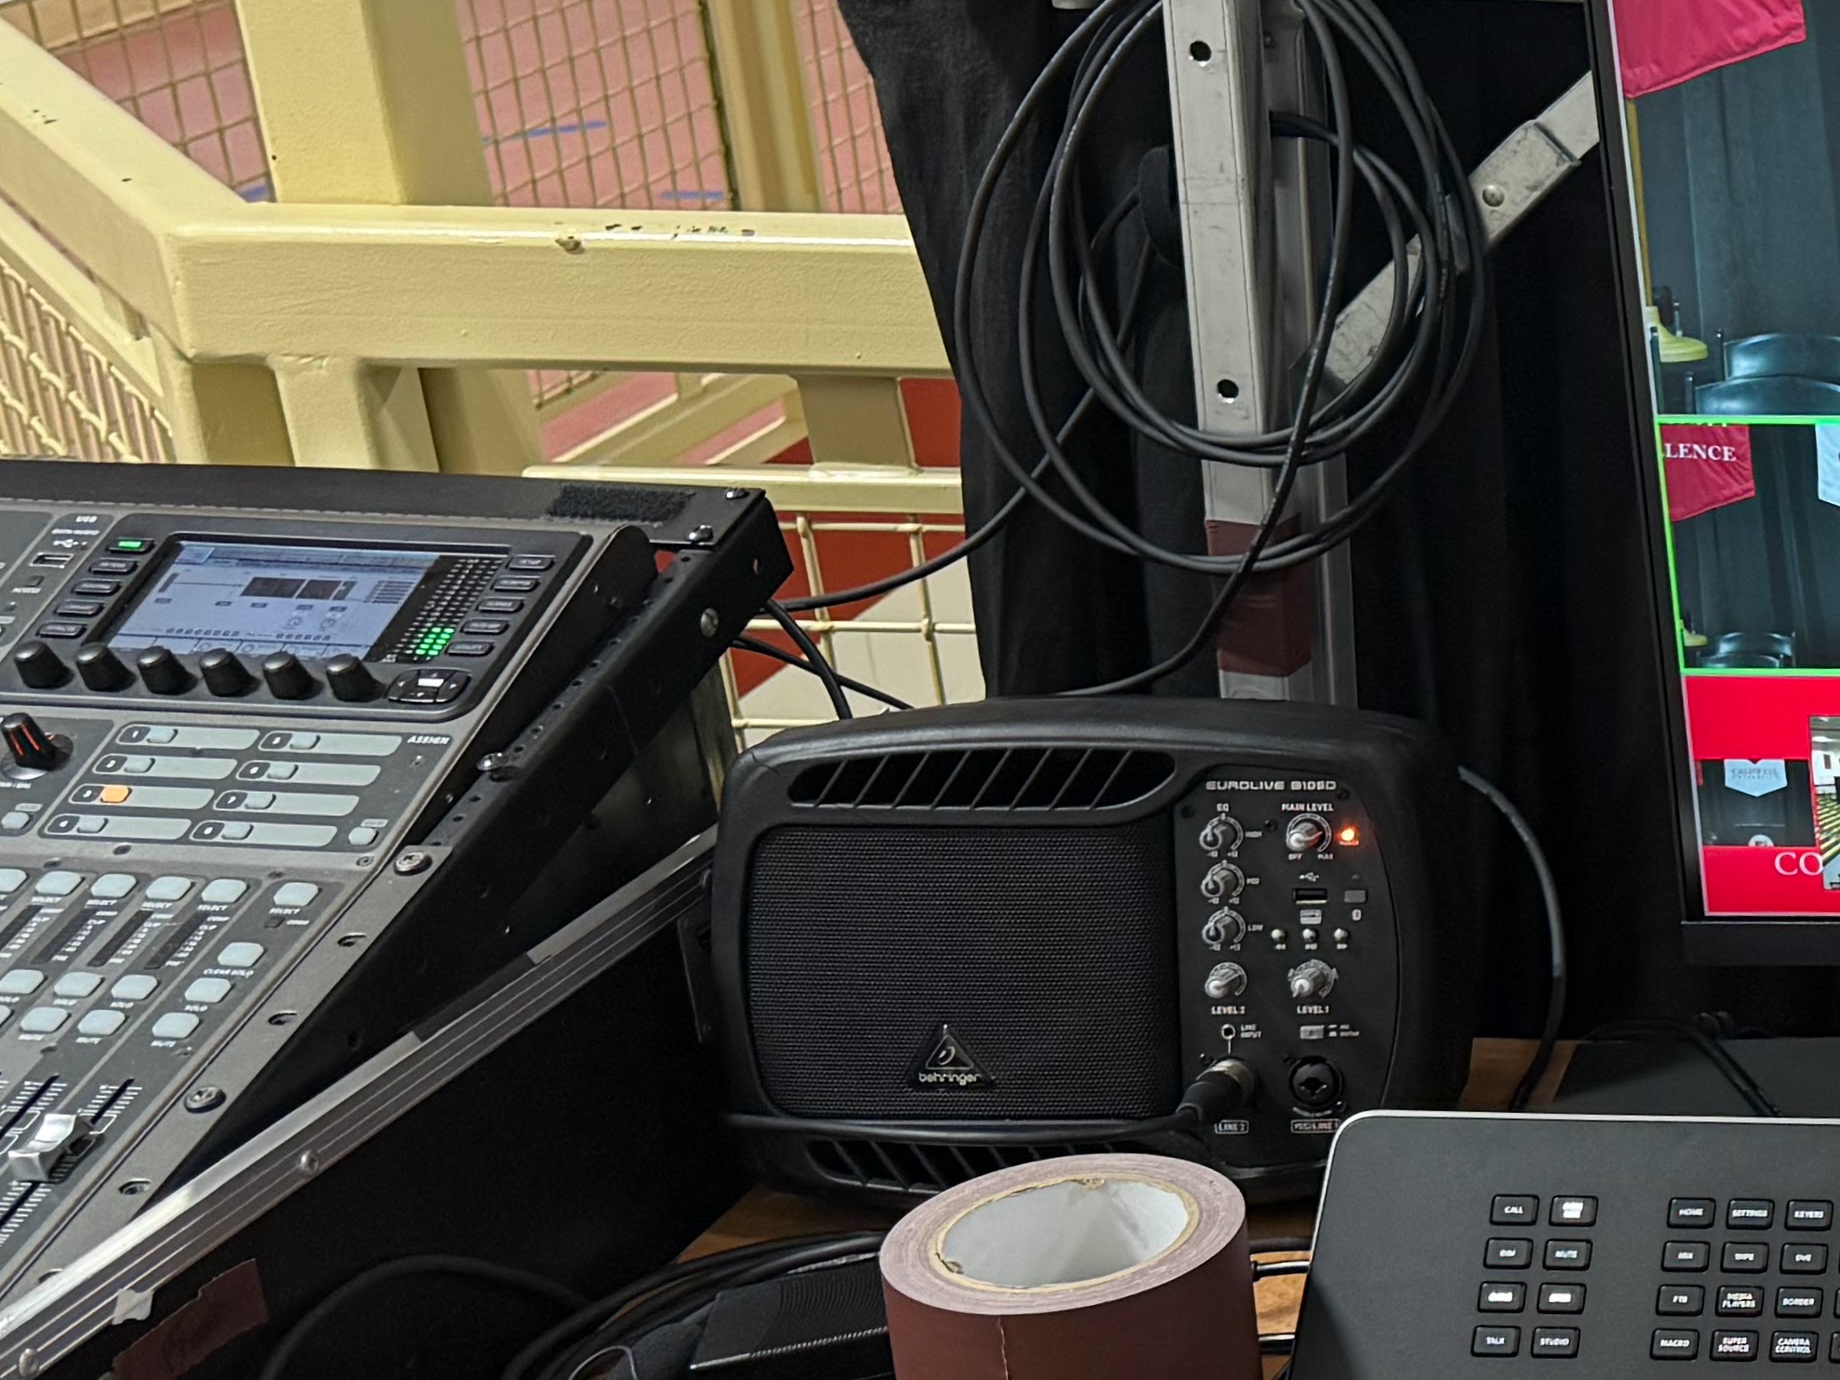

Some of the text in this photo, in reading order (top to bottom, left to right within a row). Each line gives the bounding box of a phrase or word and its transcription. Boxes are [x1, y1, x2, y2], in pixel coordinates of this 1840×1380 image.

[407, 734, 451, 746] ASSIGN
[1206, 780, 1285, 790] EUROLIVE
[1281, 803, 1334, 812] MAIN LEVEL
[1211, 1005, 1237, 1015] LEVEL
[1297, 1005, 1323, 1014] LEVEL
[918, 1071, 982, 1087] behringer
[1504, 1205, 1523, 1214] CALL
